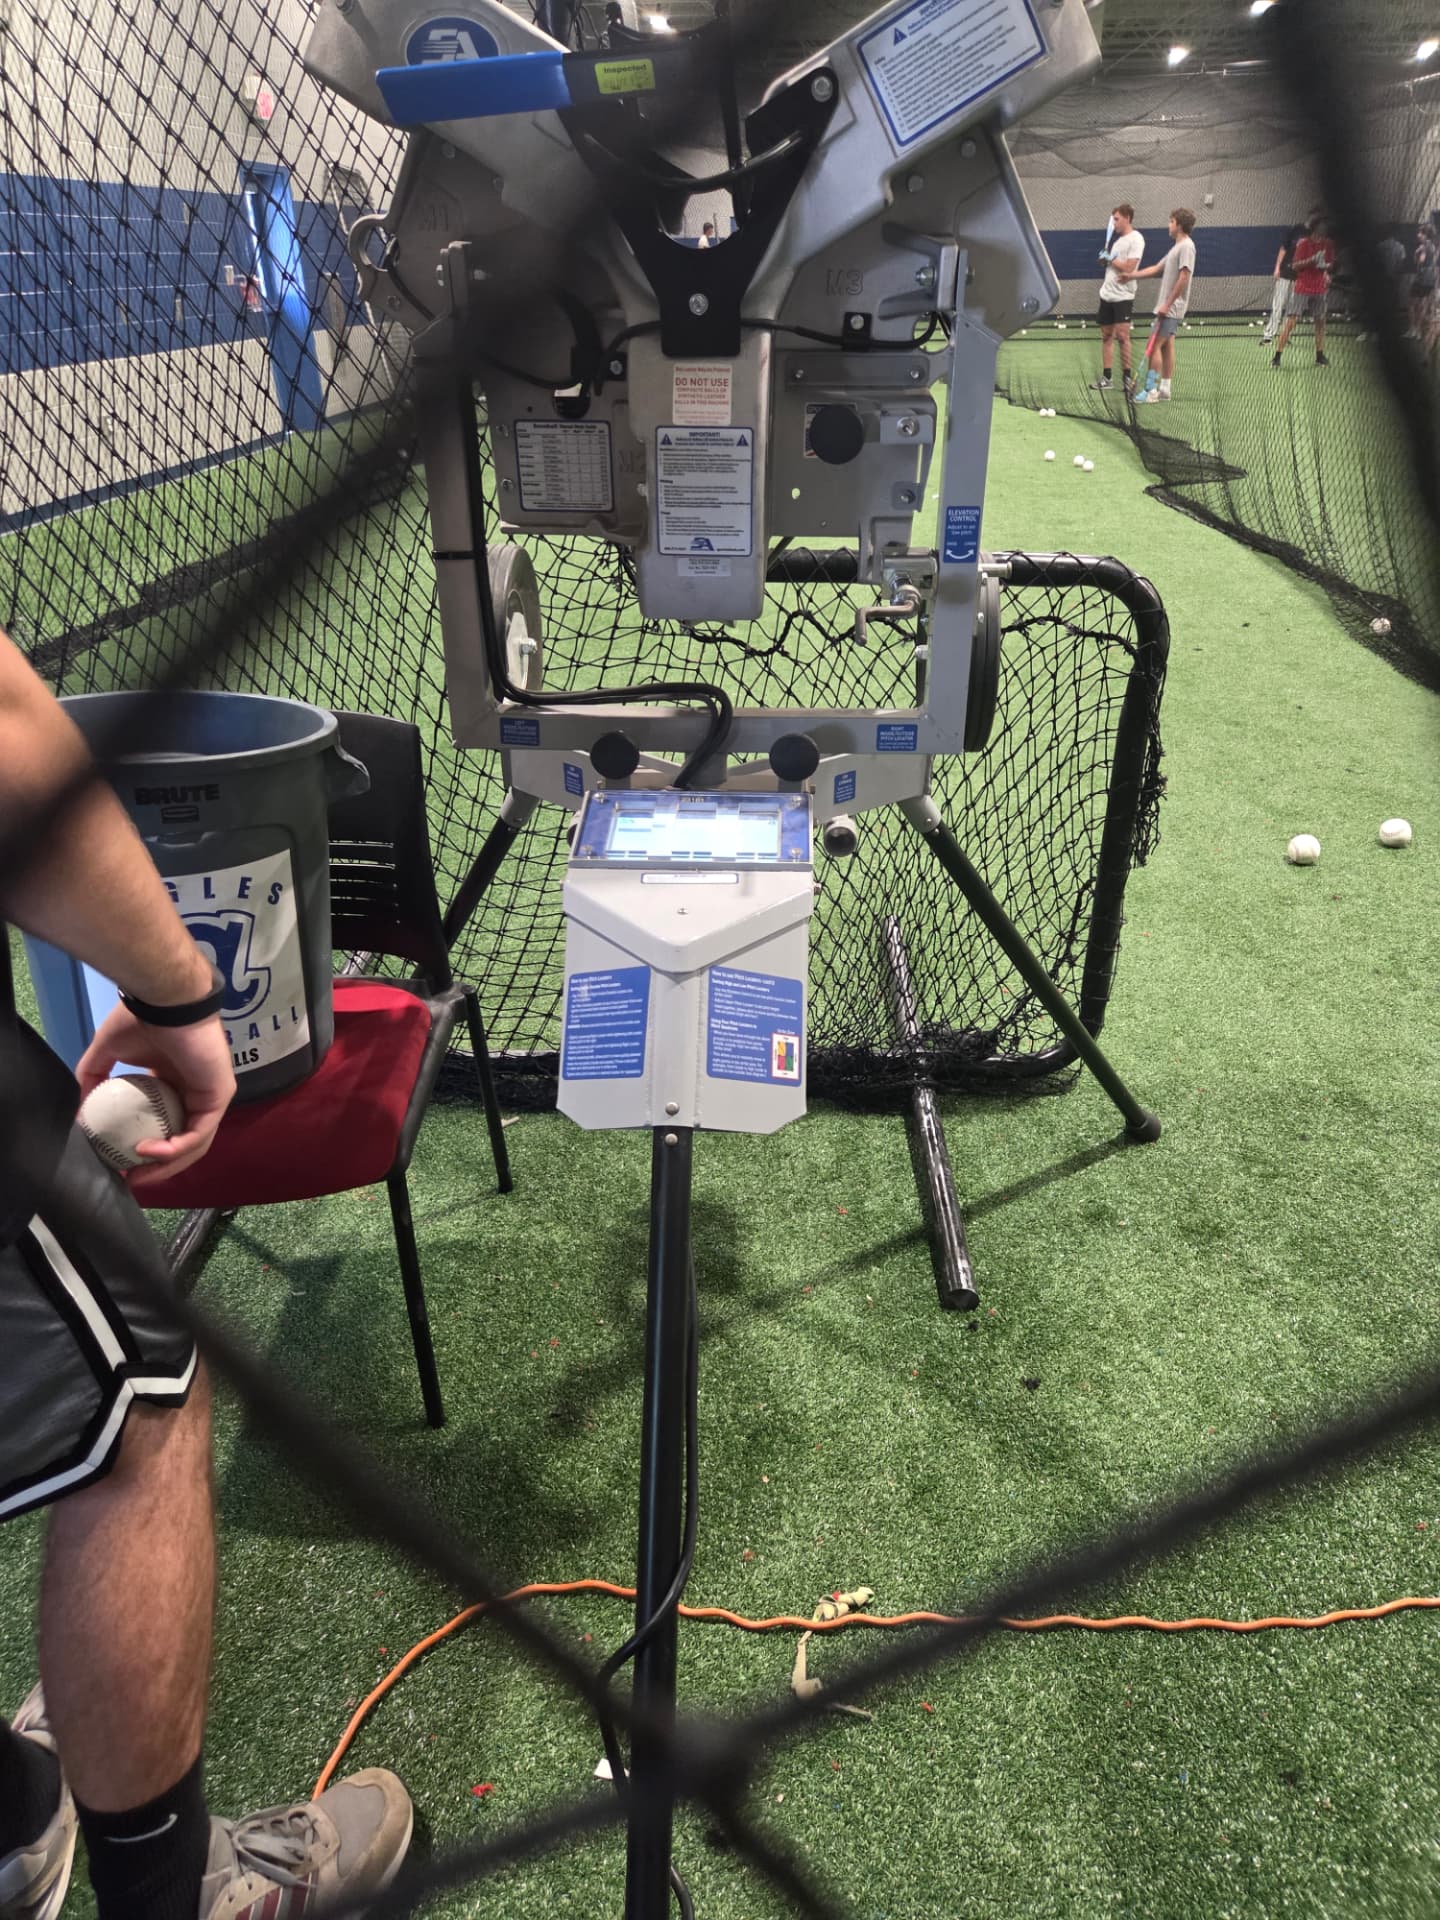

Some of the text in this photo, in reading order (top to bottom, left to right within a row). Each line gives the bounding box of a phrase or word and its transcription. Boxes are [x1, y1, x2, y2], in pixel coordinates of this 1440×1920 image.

[603, 63, 648, 74] Inspected
[826, 268, 864, 296] M3
[675, 377, 729, 387] DO NOT USE
[134, 783, 220, 806] BRUTE
